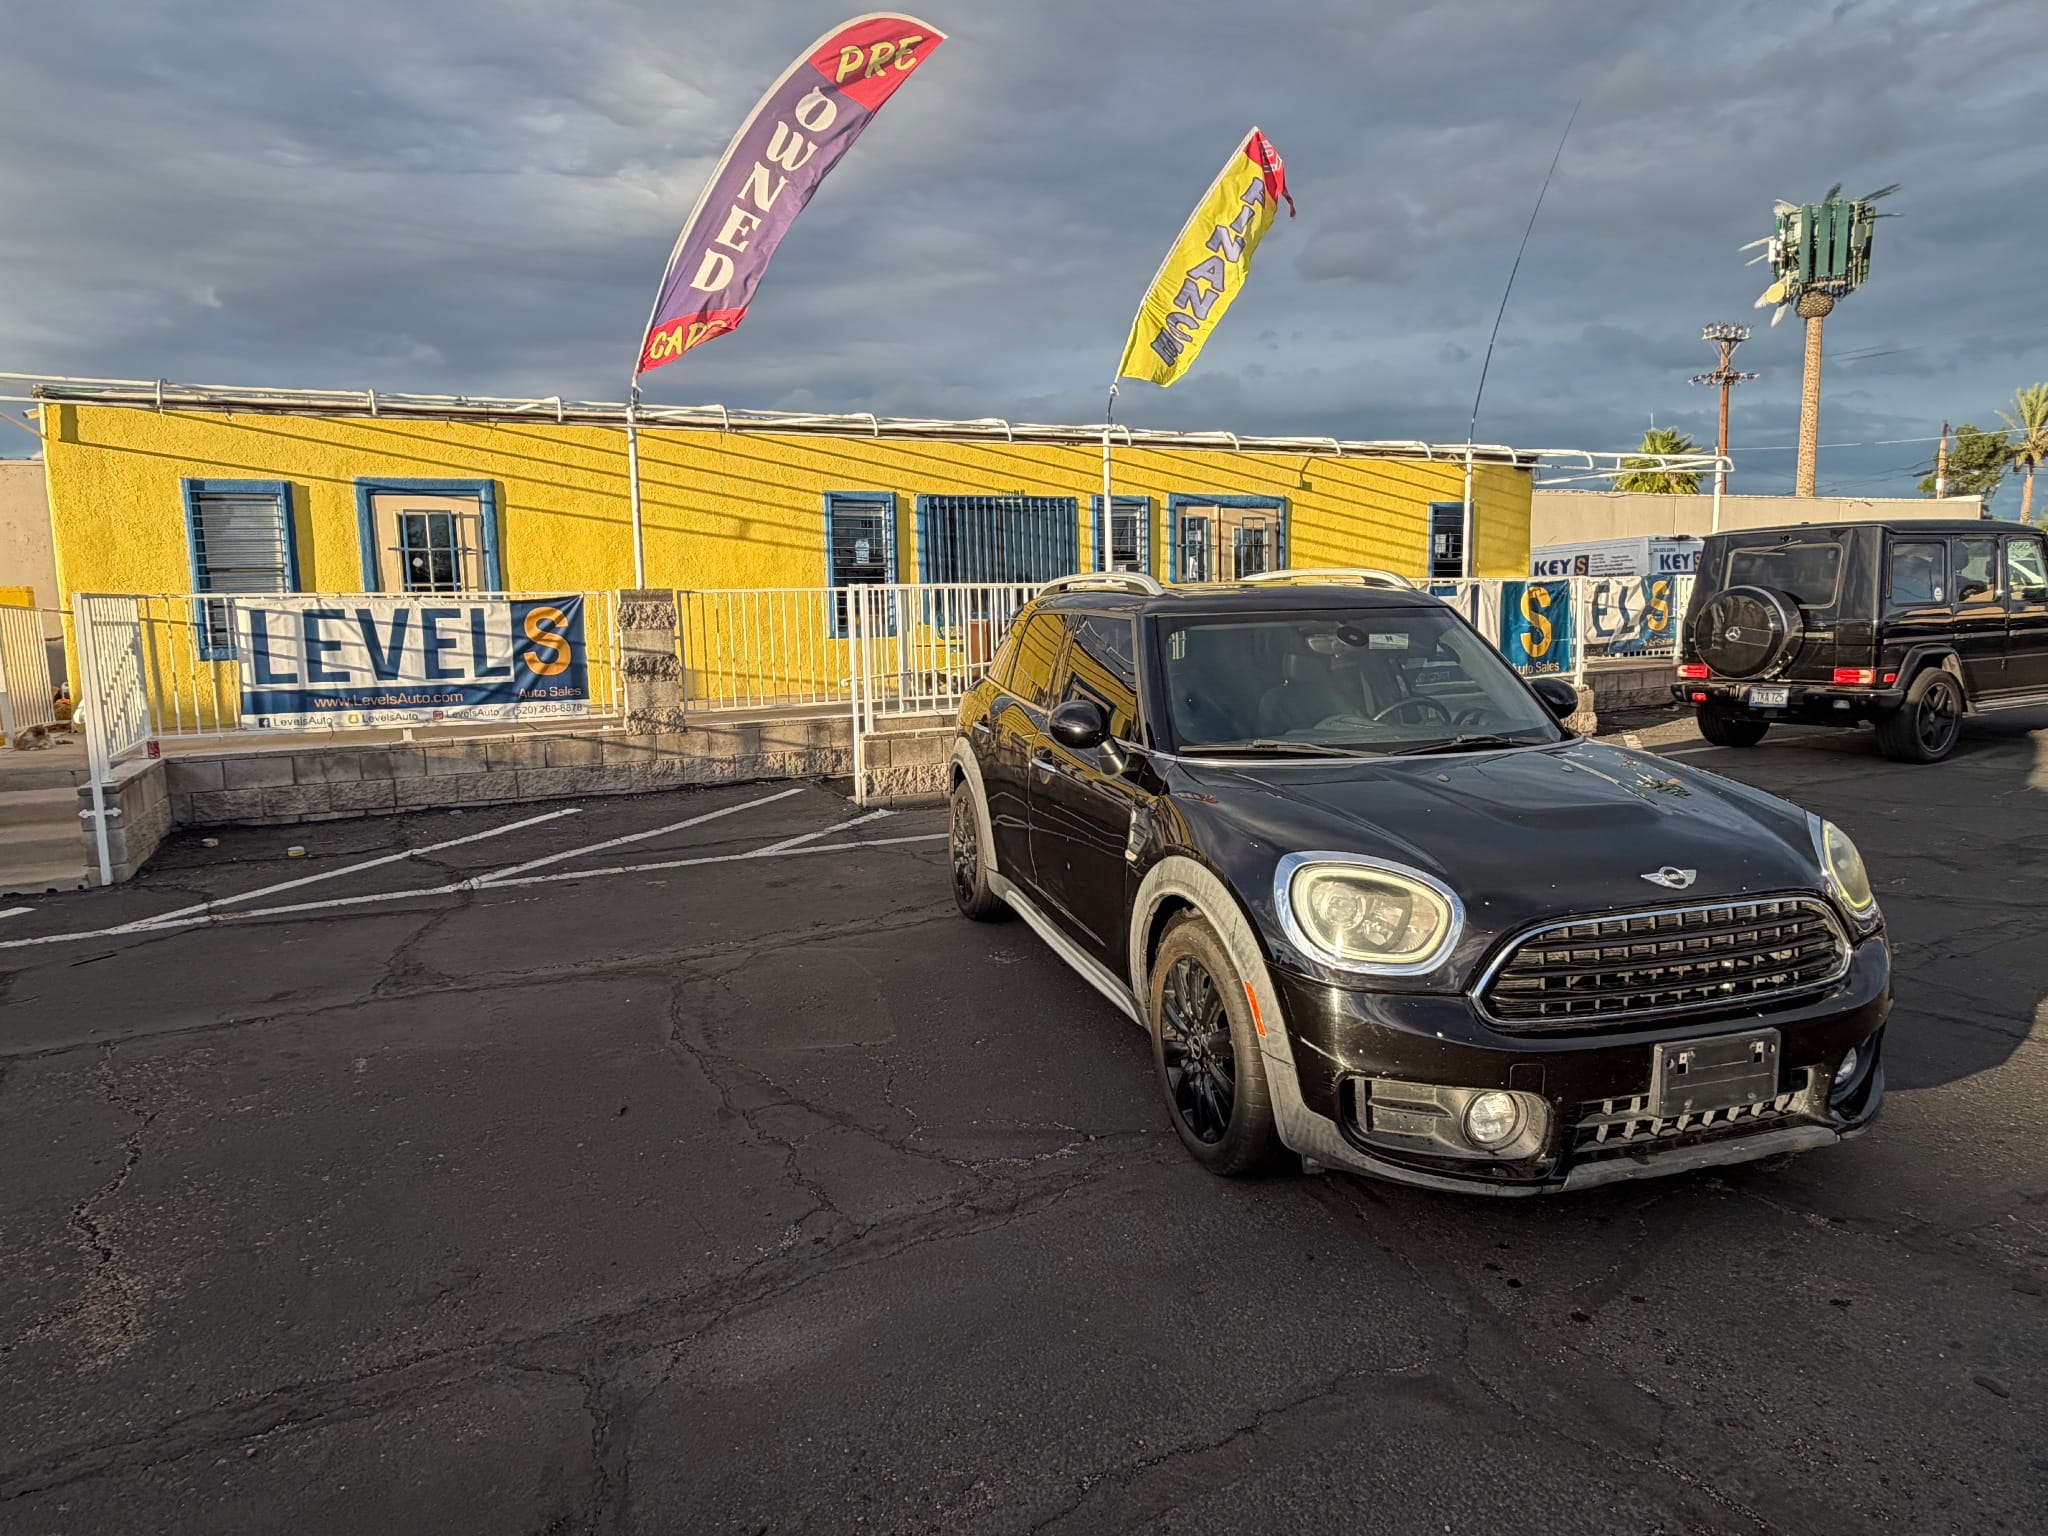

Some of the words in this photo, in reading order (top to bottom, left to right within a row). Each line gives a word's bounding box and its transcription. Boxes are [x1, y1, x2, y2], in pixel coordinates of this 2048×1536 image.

[836, 35, 923, 83] PRE
[690, 86, 837, 292] OWNED
[249, 605, 573, 686] LEVELS
[1535, 660, 1560, 674] Sales
[519, 687, 547, 699] Auto
[549, 685, 582, 697] Sales
[313, 691, 465, 708] www.LevelsAuto.com
[361, 711, 419, 723] LevelsAuto
[446, 708, 500, 719] LevelsAuto
[512, 705, 537, 716] (520)
[273, 716, 333, 728] LevelsAuto
